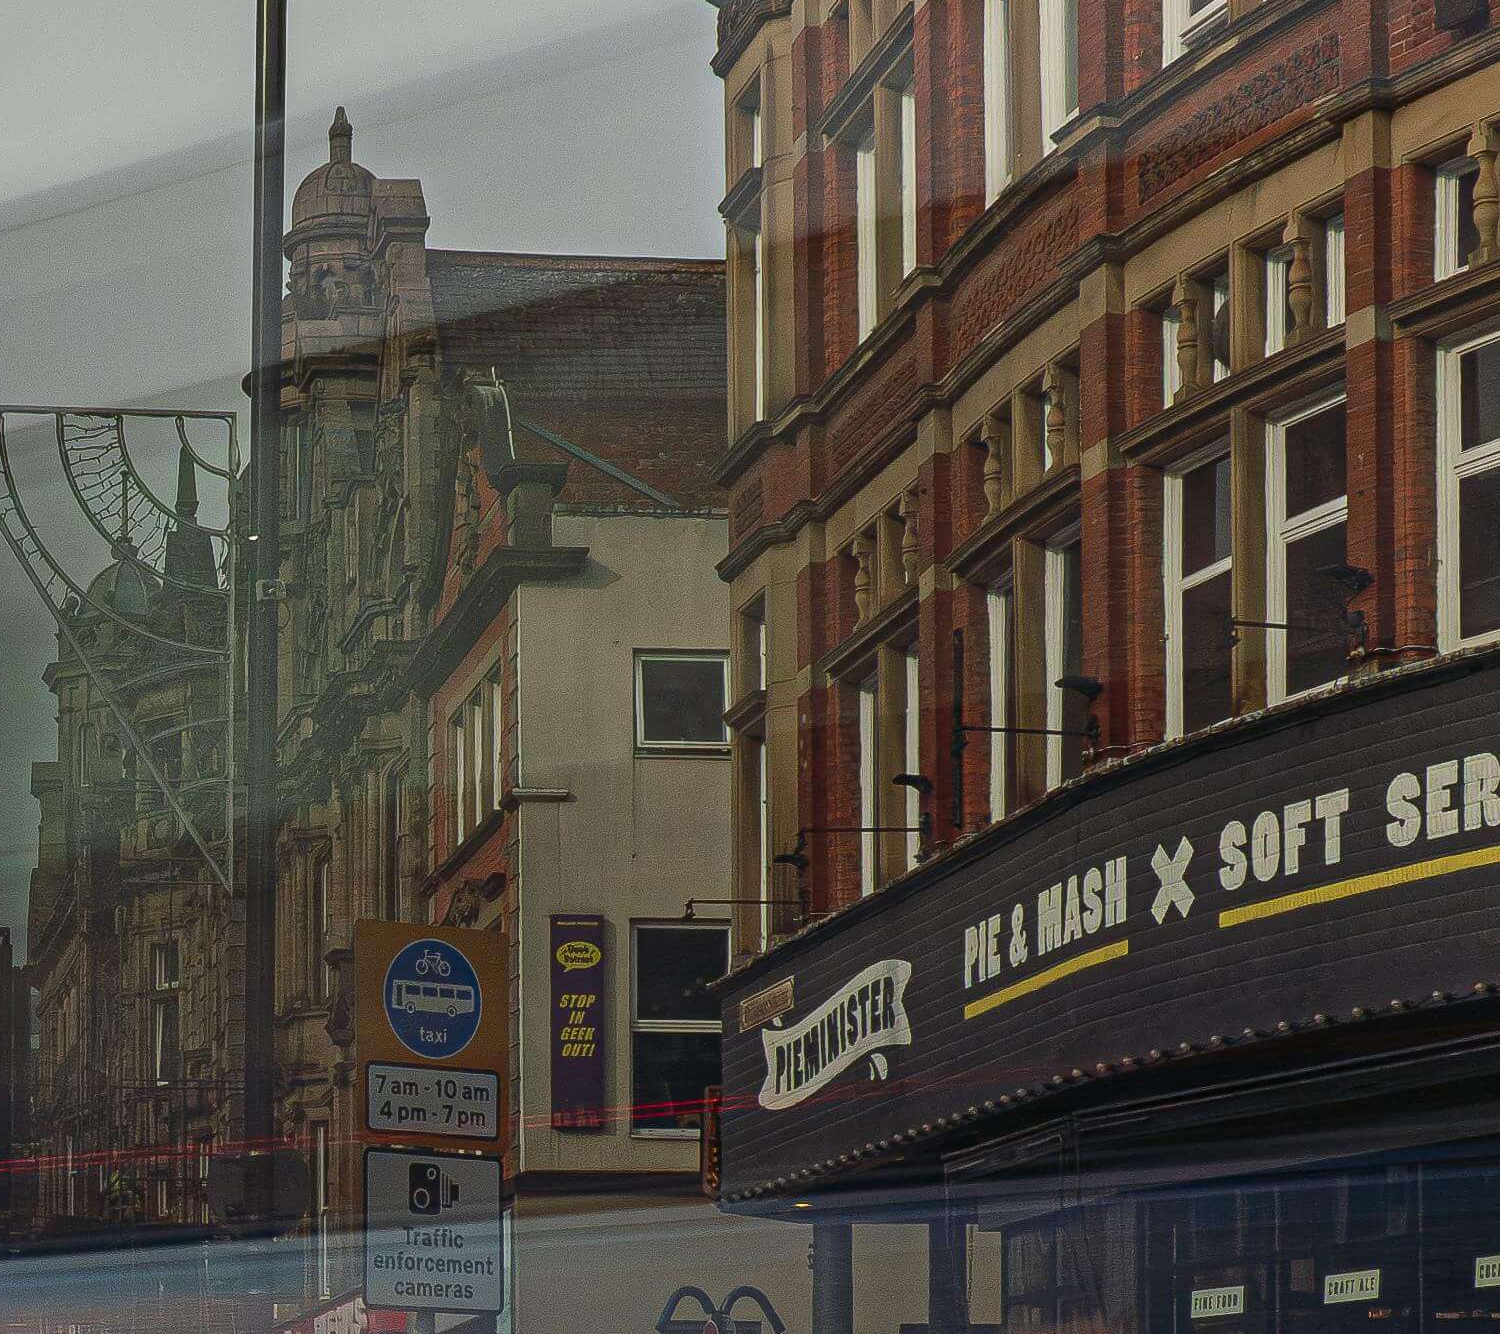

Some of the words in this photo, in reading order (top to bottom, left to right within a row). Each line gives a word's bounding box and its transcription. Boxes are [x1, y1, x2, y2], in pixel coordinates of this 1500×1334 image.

[964, 913, 1001, 989] PIE
[1009, 903, 1029, 967] &
[1037, 855, 1128, 956] MASH
[1218, 787, 1350, 891] SOFT
[560, 994, 596, 1008] STOP
[568, 1010, 585, 1024] IN
[420, 1027, 447, 1043] taxi
[560, 1027, 595, 1040] GEEK
[774, 975, 895, 1095] PIEMINISTER
[562, 1043, 597, 1057] OUT!
[375, 1074, 387, 1094] 7
[391, 1079, 419, 1097] am
[435, 1079, 458, 1098] 10
[461, 1085, 490, 1101] am
[380, 1099, 393, 1120] 4
[397, 1106, 427, 1123] pm
[442, 1104, 454, 1124] 7
[457, 1110, 486, 1127] pm
[402, 1227, 464, 1248] Traffic
[373, 1251, 494, 1275] enforcement
[394, 1280, 474, 1299] cameras
[1328, 1279, 1355, 1296] CRAFT
[1359, 1277, 1376, 1293] ALE
[1194, 1296, 1213, 1311] FINE
[1216, 1293, 1238, 1309] FOOD
